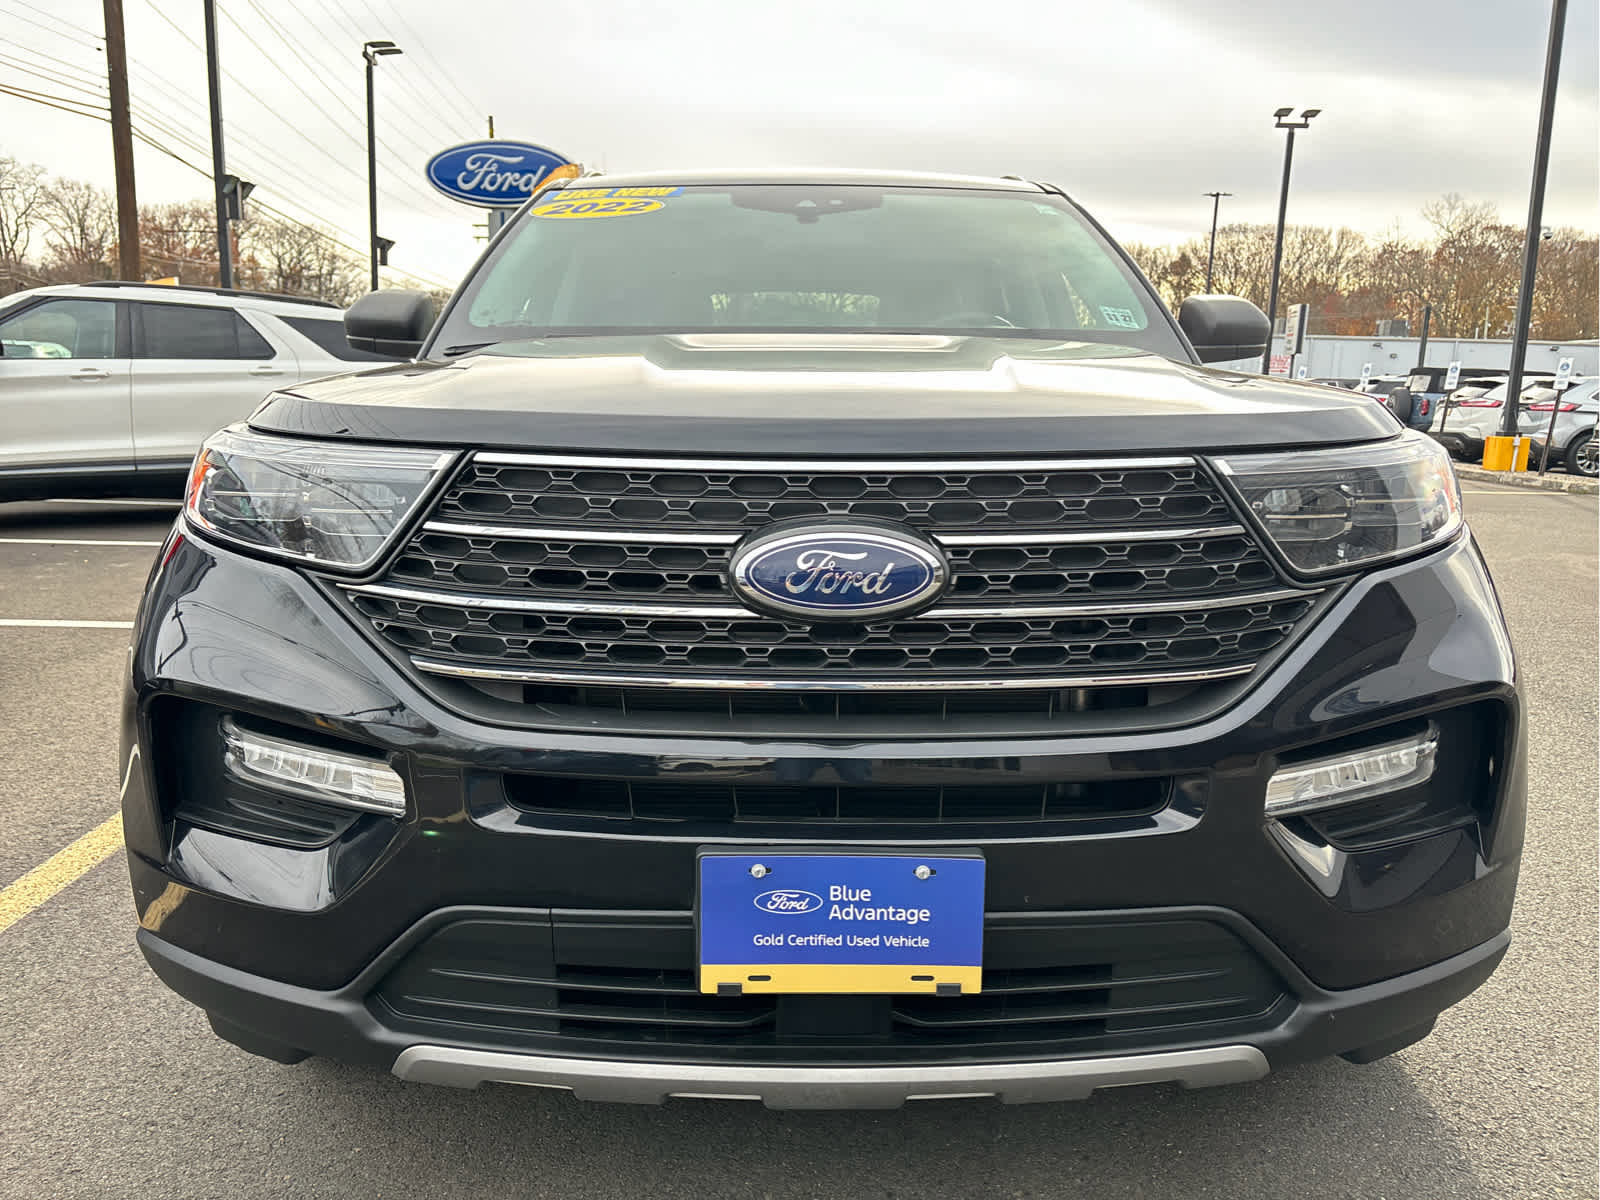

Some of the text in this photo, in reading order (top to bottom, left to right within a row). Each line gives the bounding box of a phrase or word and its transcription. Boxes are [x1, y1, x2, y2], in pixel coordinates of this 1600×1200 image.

[457, 153, 547, 193] Ford
[552, 186, 678, 201] LIKE NEW
[542, 201, 654, 215] 2022
[784, 549, 895, 595] Ford
[767, 893, 809, 911] Ford
[829, 885, 872, 902] Blue
[828, 904, 931, 925] Advantage
[753, 934, 930, 948] Gold Certified Used Vehicle
